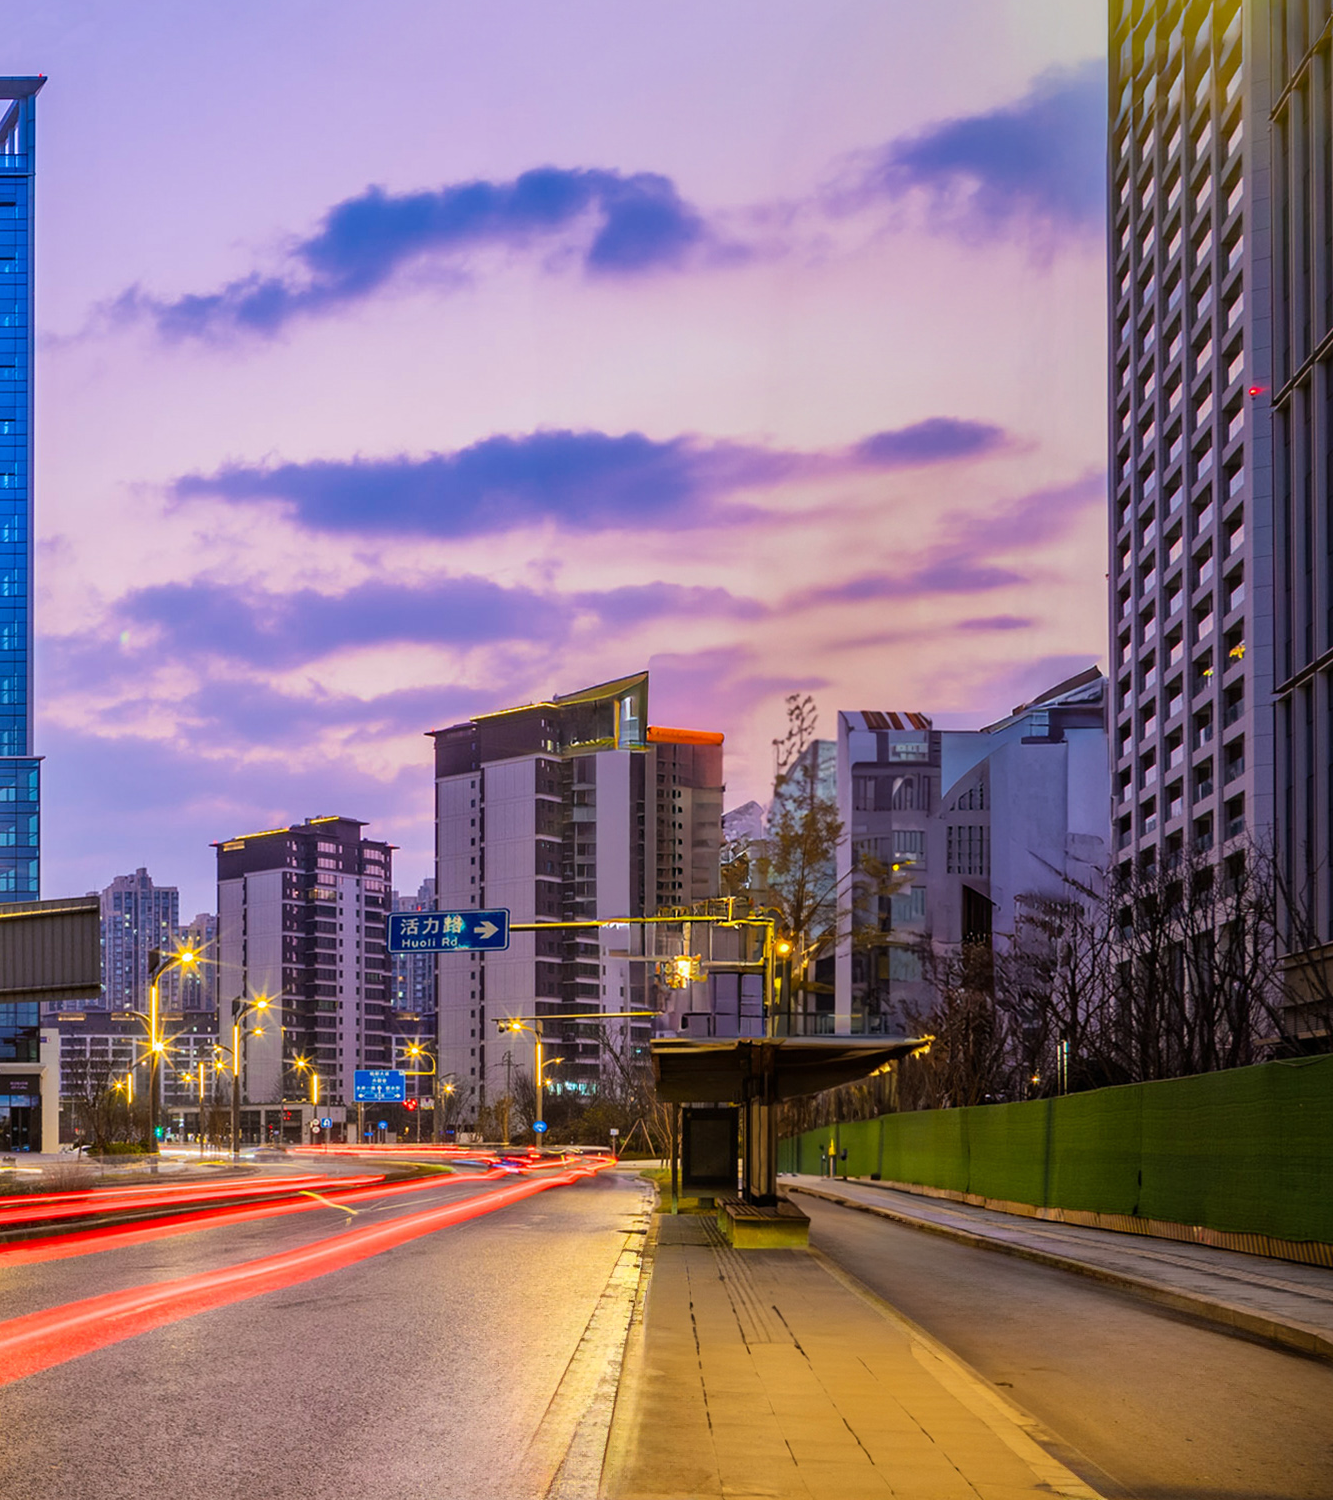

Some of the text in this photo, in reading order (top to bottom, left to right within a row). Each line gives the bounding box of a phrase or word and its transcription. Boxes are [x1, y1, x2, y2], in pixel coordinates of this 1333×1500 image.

[400, 915, 463, 935] 活力路
[401, 937, 458, 948] Huoli Rd
